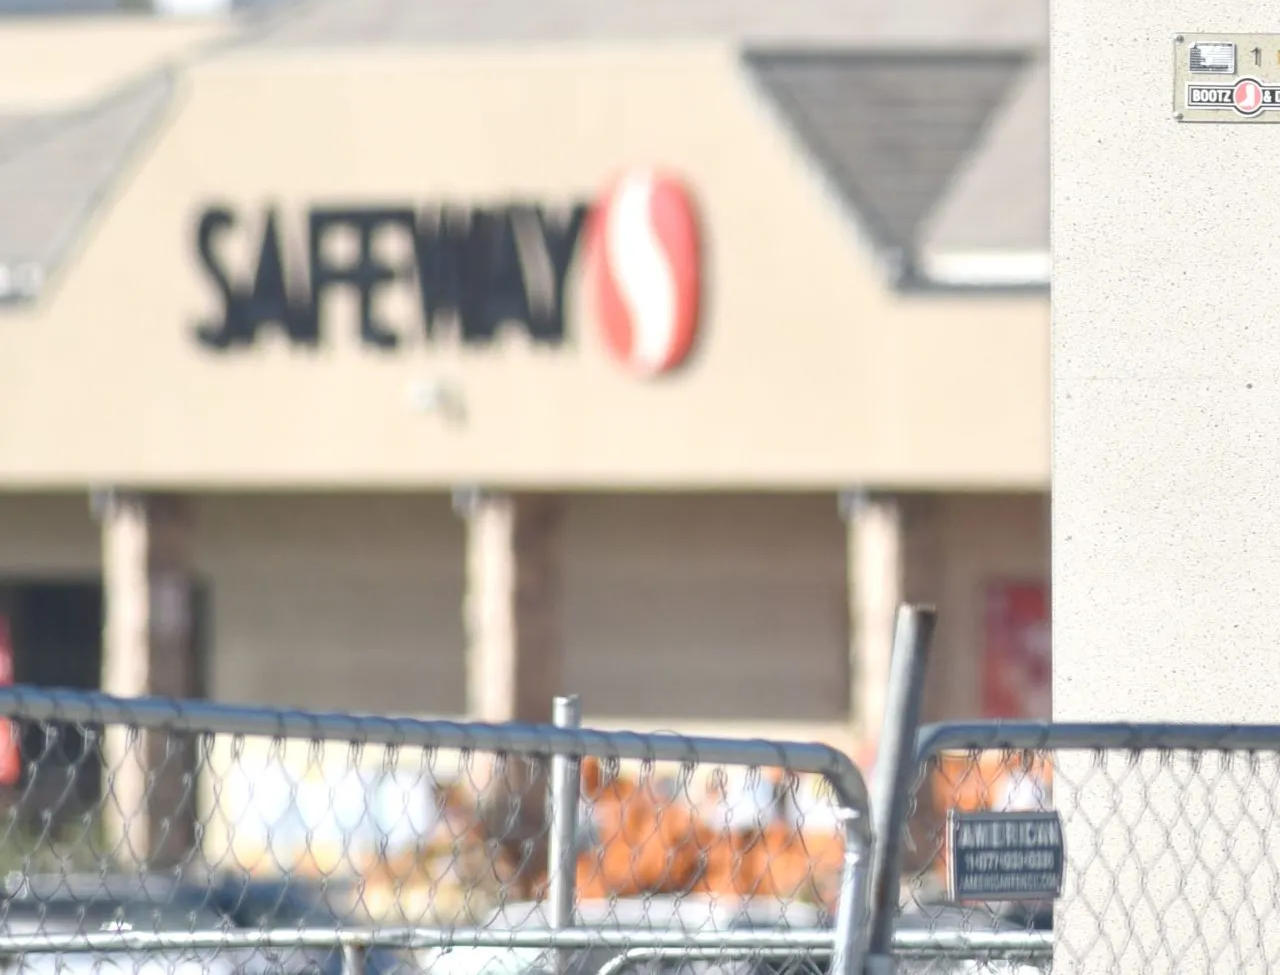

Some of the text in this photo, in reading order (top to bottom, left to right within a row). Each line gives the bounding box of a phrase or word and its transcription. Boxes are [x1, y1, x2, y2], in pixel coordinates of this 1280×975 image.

[1192, 89, 1232, 103] BOOTZ
[1262, 90, 1272, 103] &
[189, 202, 594, 351] SAFEWAY
[956, 821, 1059, 848] AMERICAN
